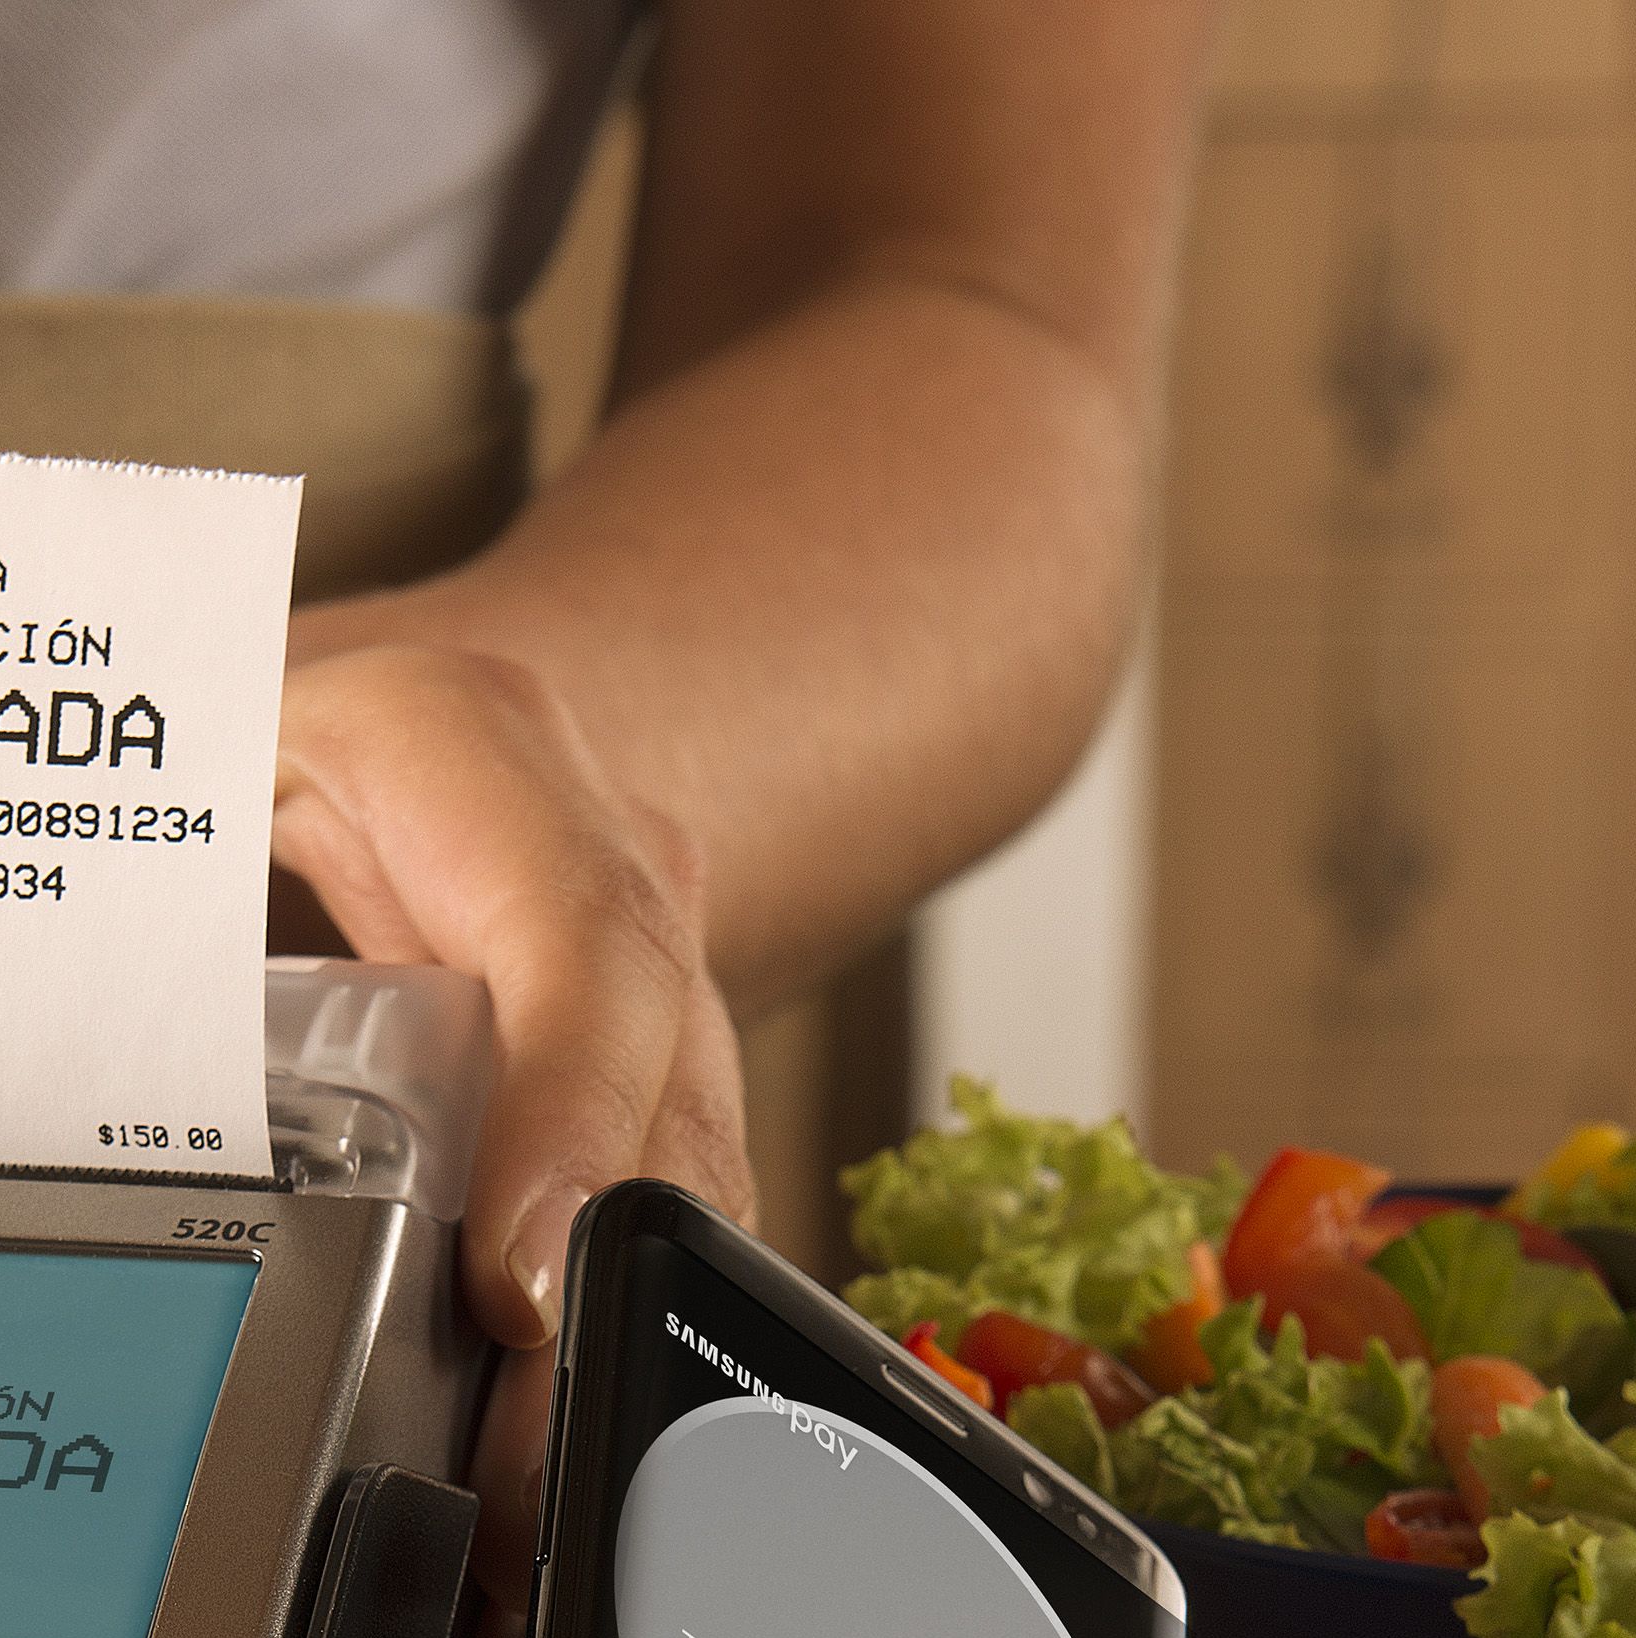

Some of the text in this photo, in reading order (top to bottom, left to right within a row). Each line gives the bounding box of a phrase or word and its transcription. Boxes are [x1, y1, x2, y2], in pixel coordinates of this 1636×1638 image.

[98, 1124, 223, 1151] $150.00
[171, 1217, 275, 1244] 520C
[665, 1312, 859, 1471] SAMSUNG pay
